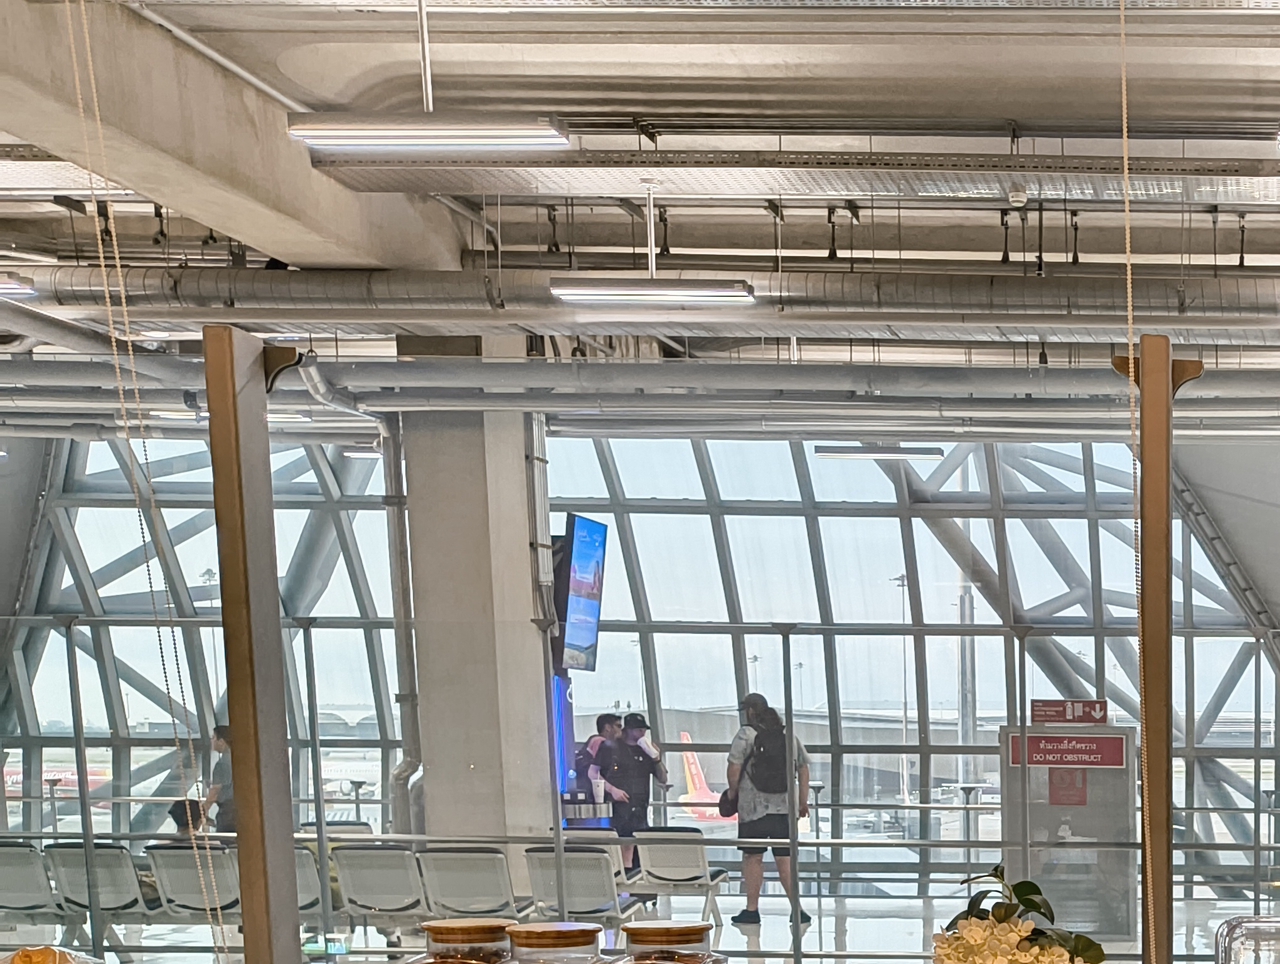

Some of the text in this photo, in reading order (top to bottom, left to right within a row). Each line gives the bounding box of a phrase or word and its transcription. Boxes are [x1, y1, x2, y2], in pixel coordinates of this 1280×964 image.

[1033, 753, 1102, 762] DO NOT OBSTRUCT
